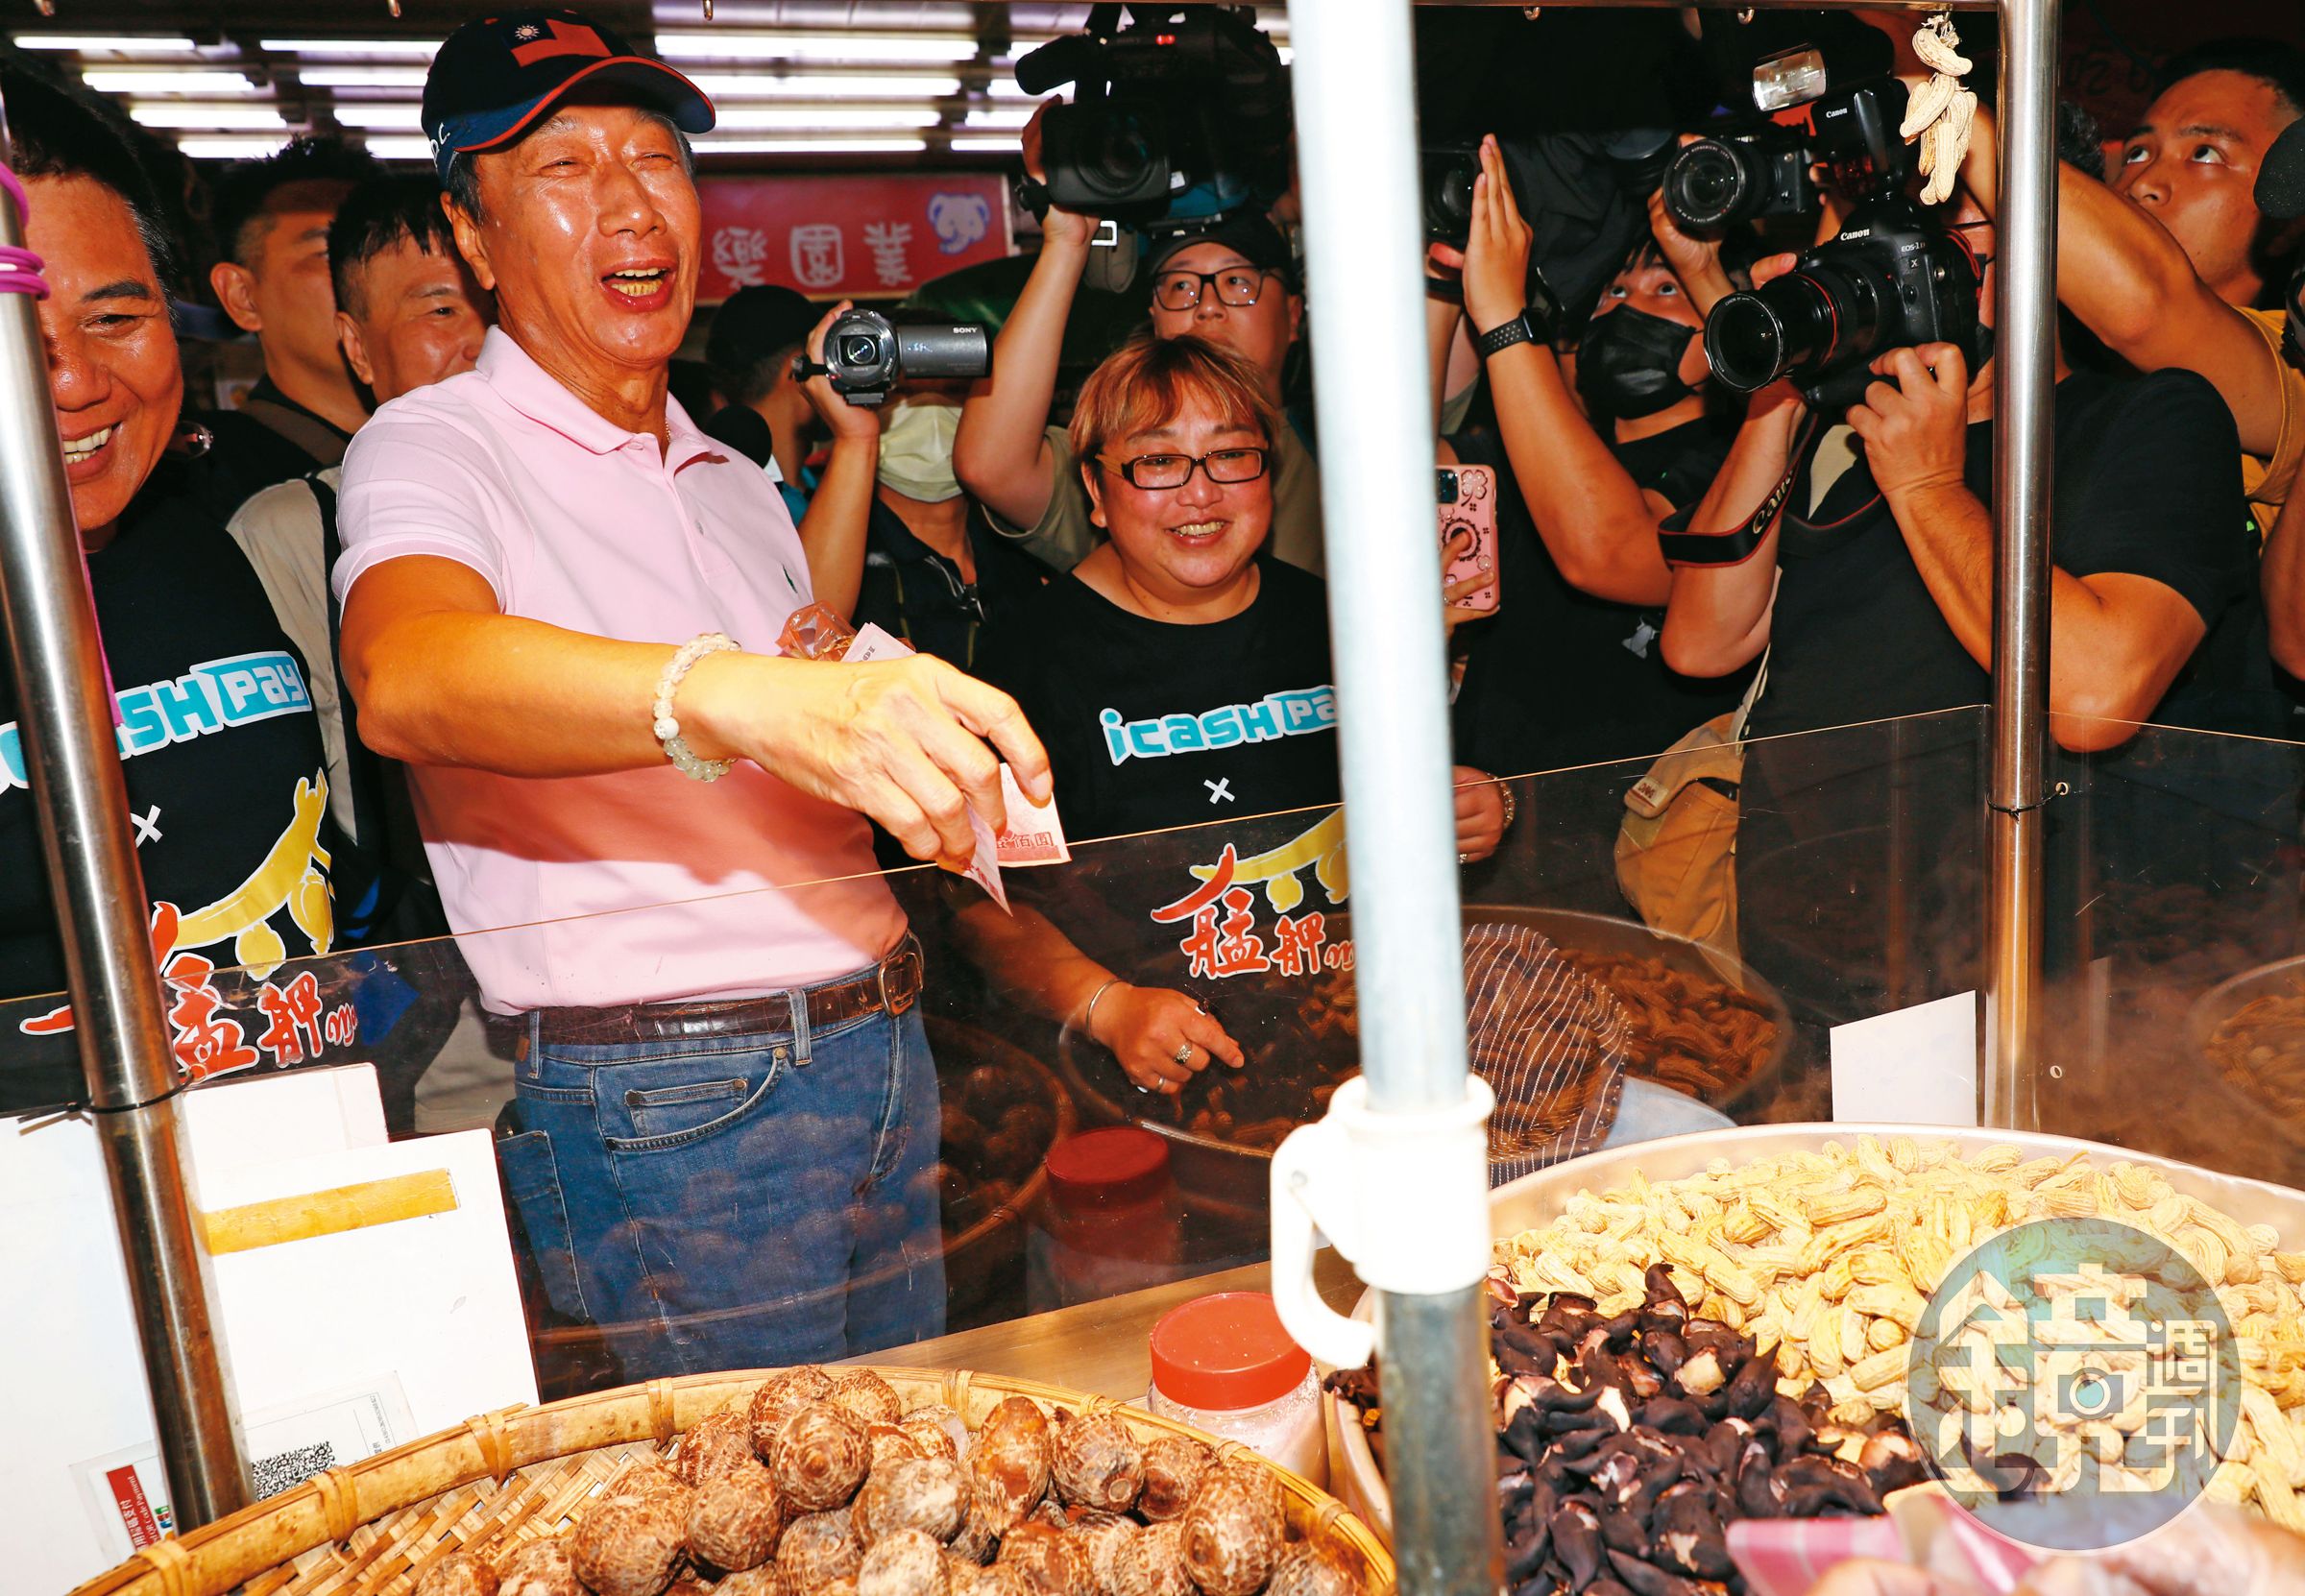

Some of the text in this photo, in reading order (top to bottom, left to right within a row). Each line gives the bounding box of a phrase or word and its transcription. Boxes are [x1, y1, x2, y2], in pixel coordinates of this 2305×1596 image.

[1826, 109, 1848, 118] Canon
[1840, 229, 1871, 241] Canon
[127, 1475, 145, 1506] Payment
